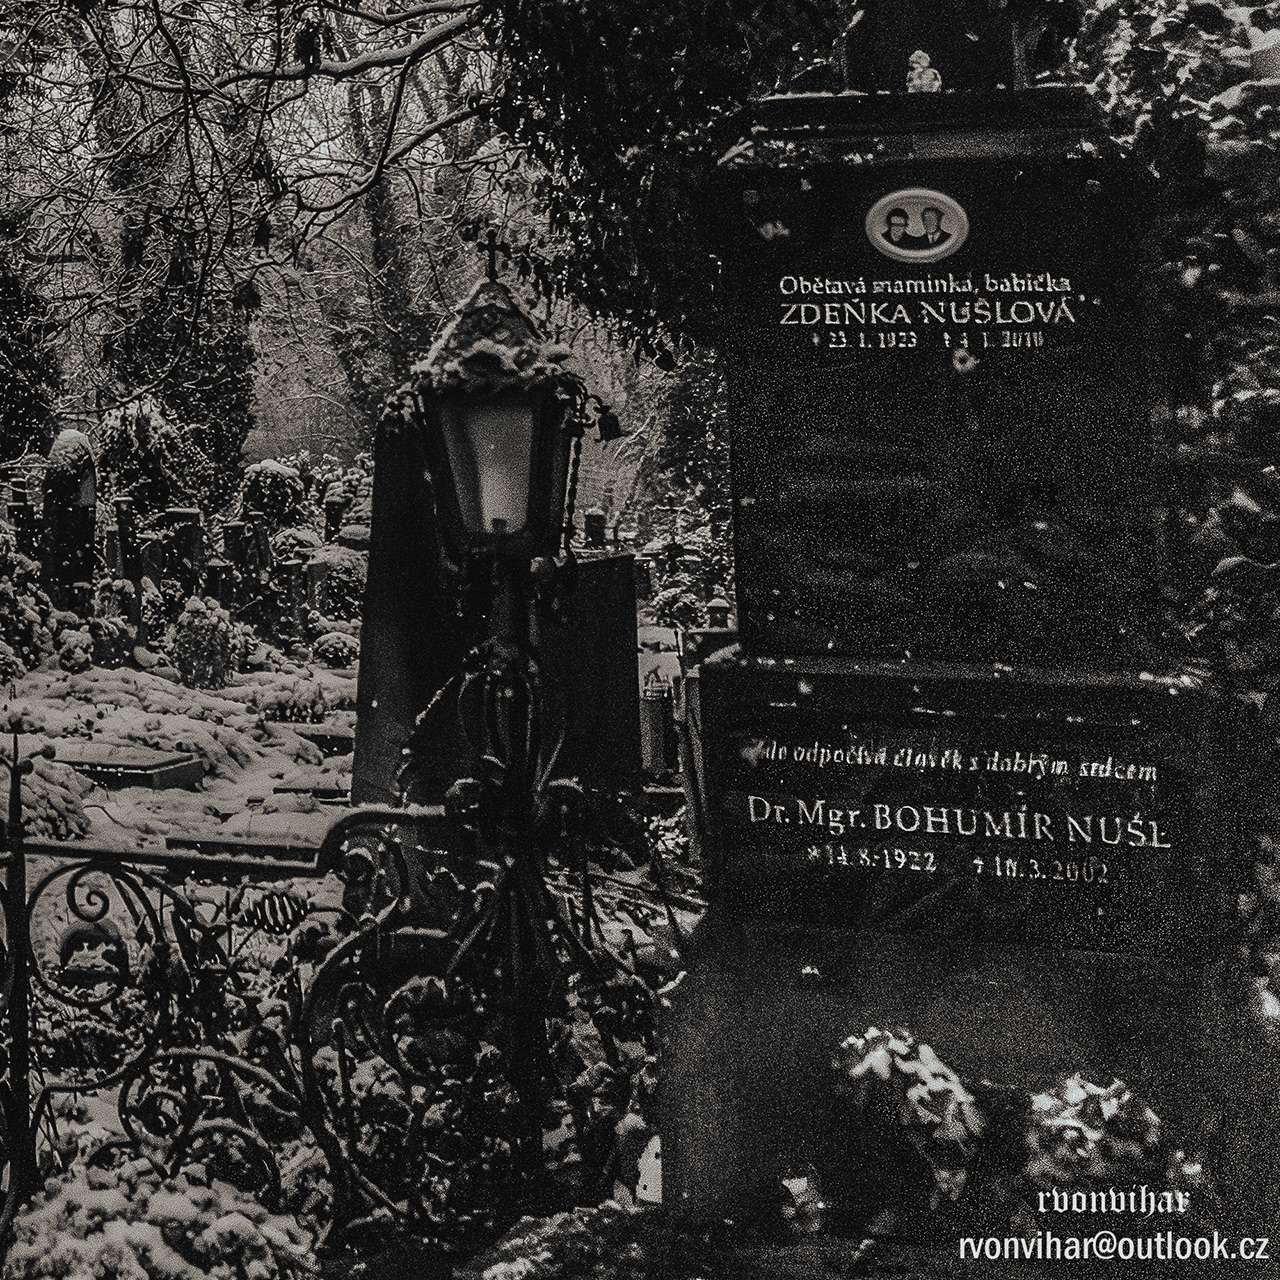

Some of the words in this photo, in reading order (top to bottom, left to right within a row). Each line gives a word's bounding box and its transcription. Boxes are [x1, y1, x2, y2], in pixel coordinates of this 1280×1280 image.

[780, 275, 866, 295] Obětavá
[984, 272, 1072, 293] babička
[780, 298, 912, 325] ZDEŇKA
[747, 794, 790, 824] Dr.
[797, 798, 866, 837] Mgr.
[873, 801, 1055, 842] BOHUMÍR
